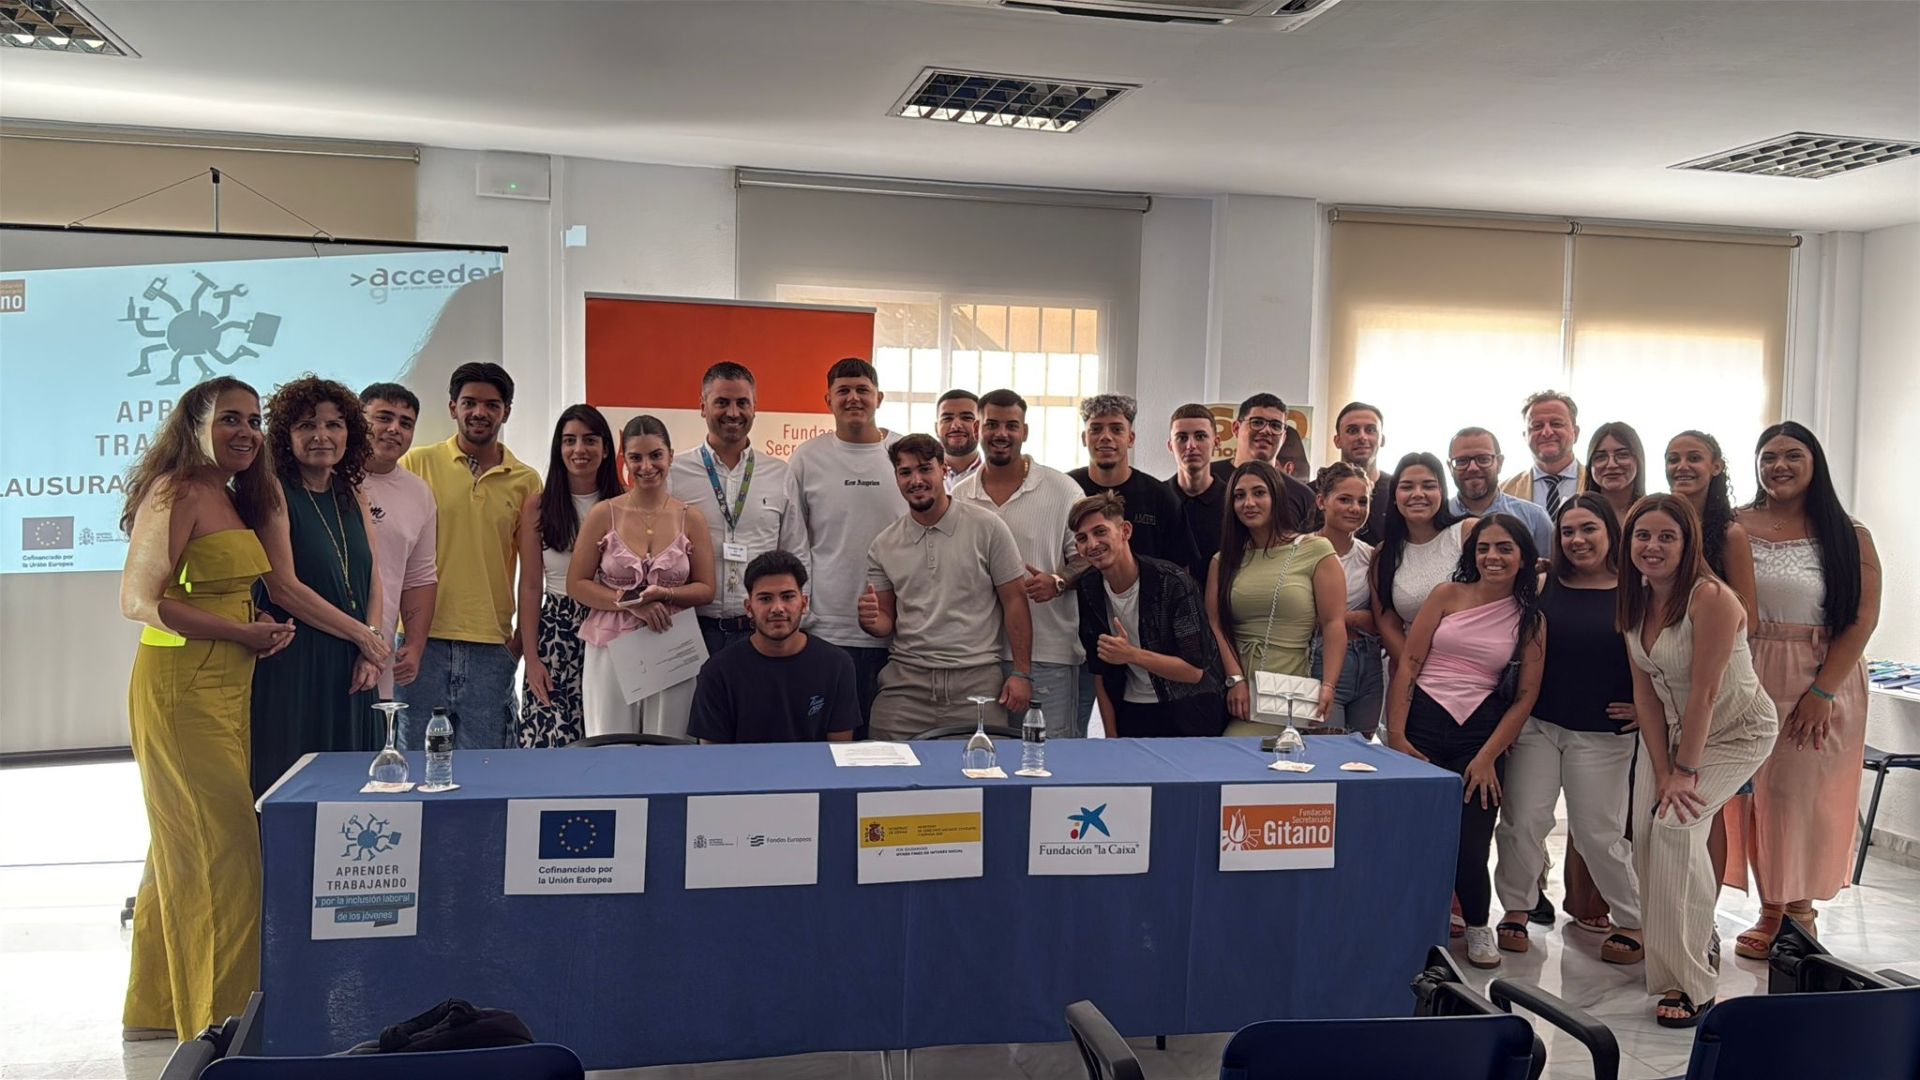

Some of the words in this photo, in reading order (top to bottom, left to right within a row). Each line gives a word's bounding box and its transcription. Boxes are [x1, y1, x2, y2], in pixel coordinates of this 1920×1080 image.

[0, 475, 125, 498] AUSURA
[1299, 808, 1331, 816] Fundación
[1292, 815, 1331, 824] Secretariado
[1264, 820, 1331, 845] Gitano
[1039, 844, 1092, 855] Fundación
[336, 864, 399, 877] APRENDER
[538, 865, 596, 874] Cofinanciado
[598, 866, 613, 874] por
[326, 878, 407, 891] TRABAJANDO
[548, 876, 574, 884] Unión
[576, 875, 612, 885] Europea
[321, 898, 336, 906] por
[337, 896, 344, 905] la
[346, 895, 381, 904] inclusión
[383, 893, 410, 903] laboral
[337, 913, 347, 921] de
[349, 912, 360, 920] los
[361, 911, 393, 922] jóvenes
